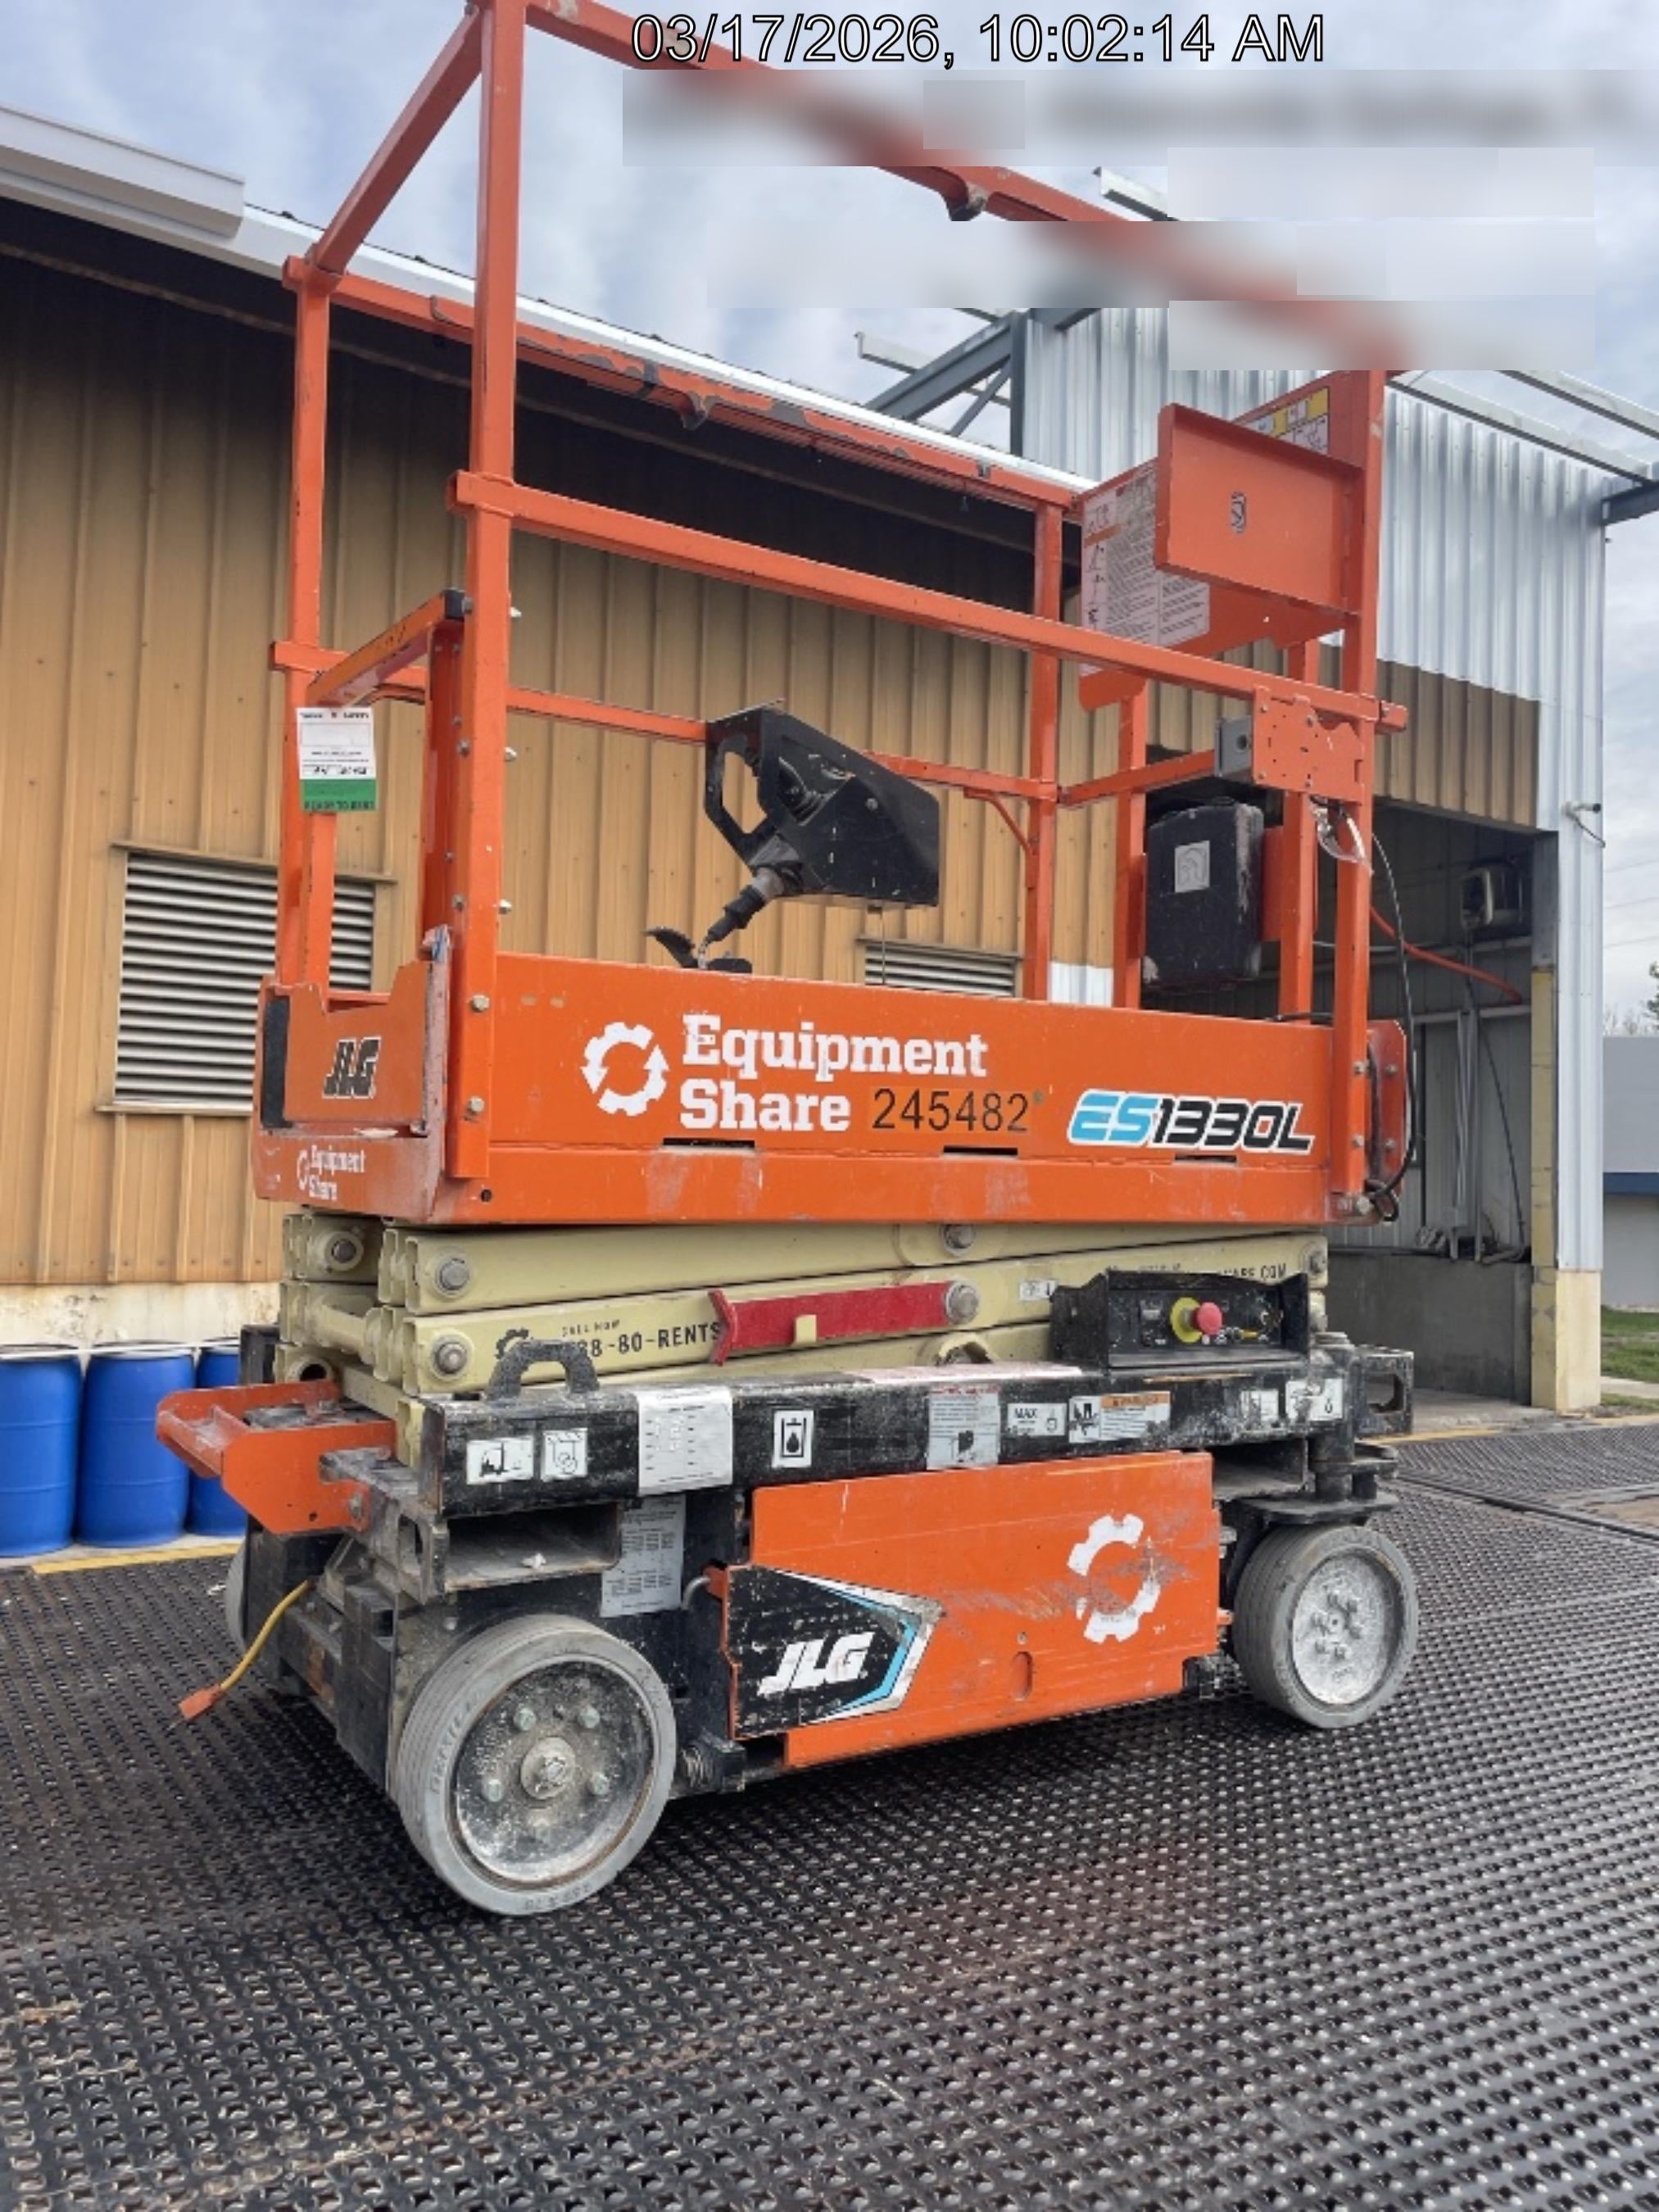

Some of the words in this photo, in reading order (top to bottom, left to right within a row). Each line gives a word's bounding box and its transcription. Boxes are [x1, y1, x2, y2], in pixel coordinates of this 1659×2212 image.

[323, 1036, 382, 1099] JLG
[682, 1013, 989, 1082] Equipment
[679, 1077, 851, 1132] Share
[871, 1087, 1030, 1132] 245482
[1067, 1089, 1316, 1154] ES1330L
[308, 1174, 338, 1201] Share
[310, 1144, 366, 1176] Equipment
[757, 1631, 875, 1696] JLG
